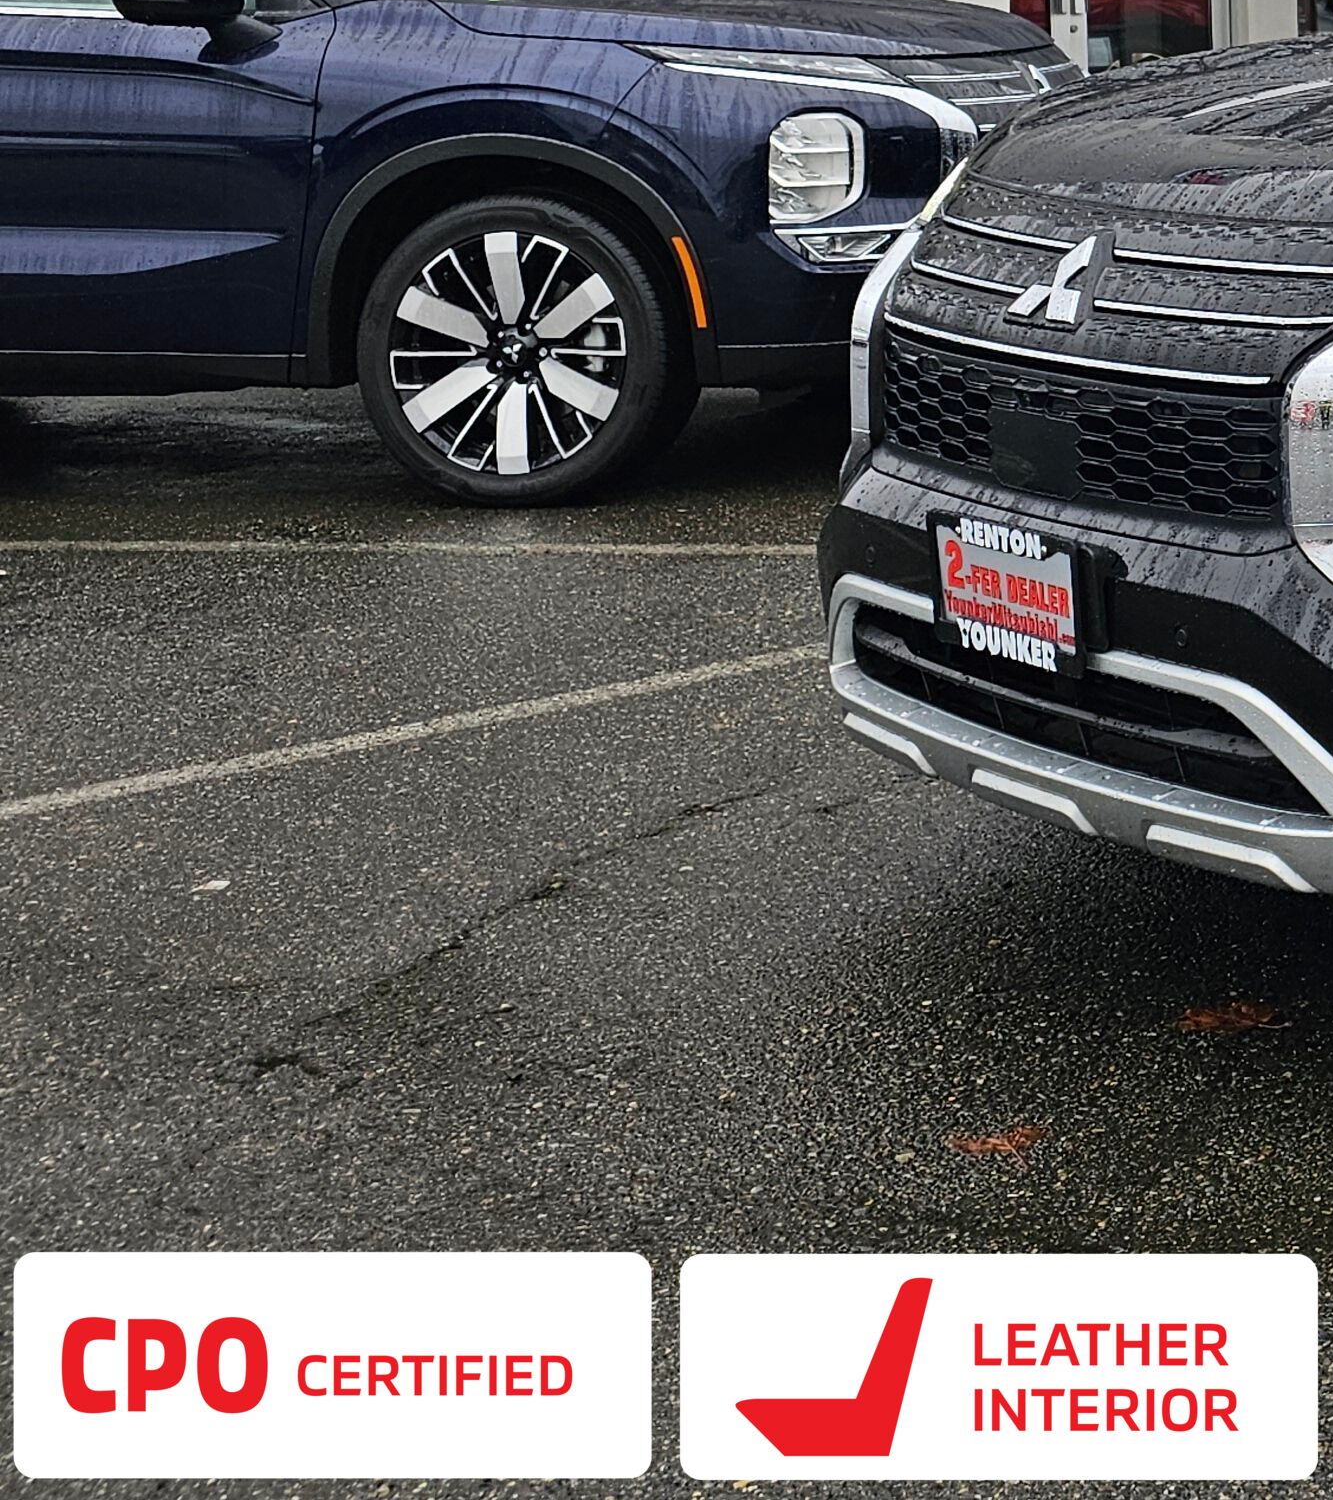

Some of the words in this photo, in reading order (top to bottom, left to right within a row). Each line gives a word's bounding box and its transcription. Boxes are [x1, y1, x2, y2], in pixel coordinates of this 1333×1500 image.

[960, 517, 1042, 560] RENTON
[944, 539, 1002, 600] 2-FER
[1005, 573, 1071, 619] DEALER
[955, 617, 1058, 672] YOUNKER
